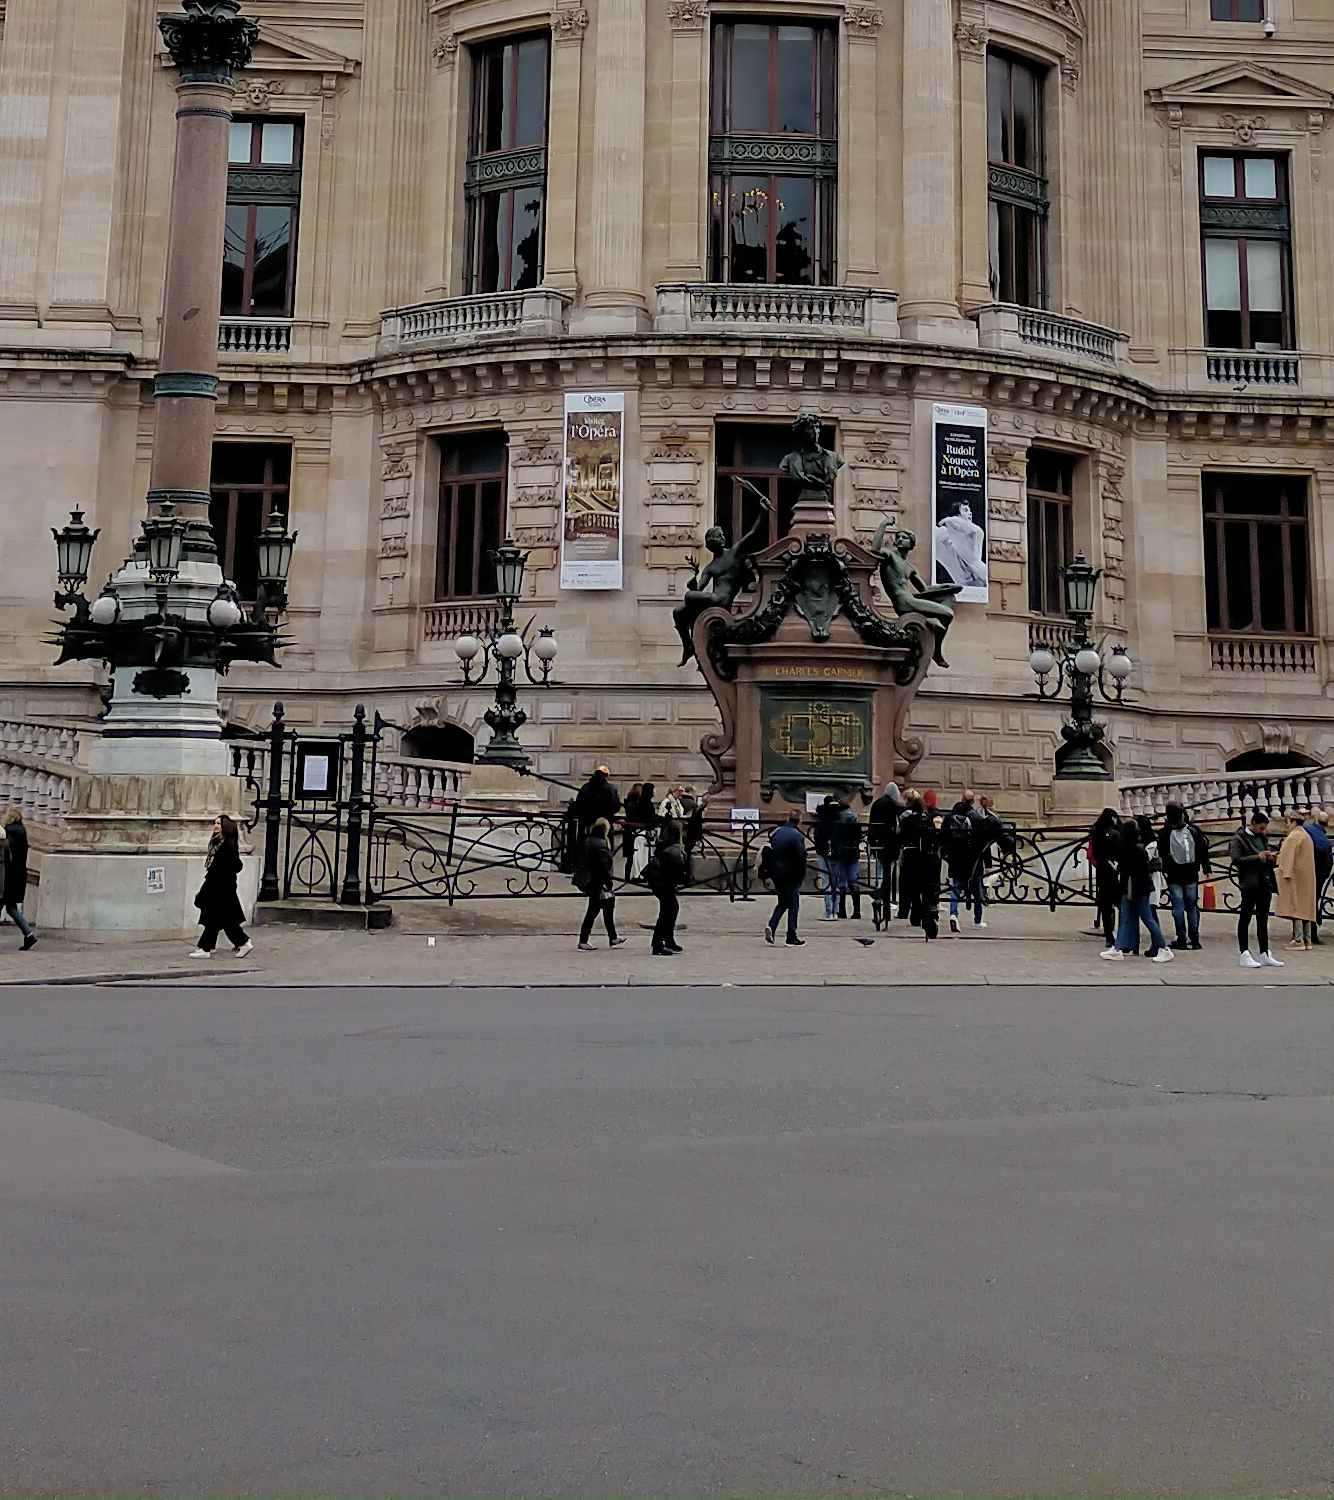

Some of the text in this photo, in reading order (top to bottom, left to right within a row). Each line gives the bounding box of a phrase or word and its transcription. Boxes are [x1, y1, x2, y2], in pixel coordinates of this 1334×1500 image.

[571, 425, 617, 441] l'Opéra
[946, 443, 976, 457] Rudolf
[948, 465, 980, 479] l'Opéra
[775, 666, 863, 678] CHARLES GARNIER
